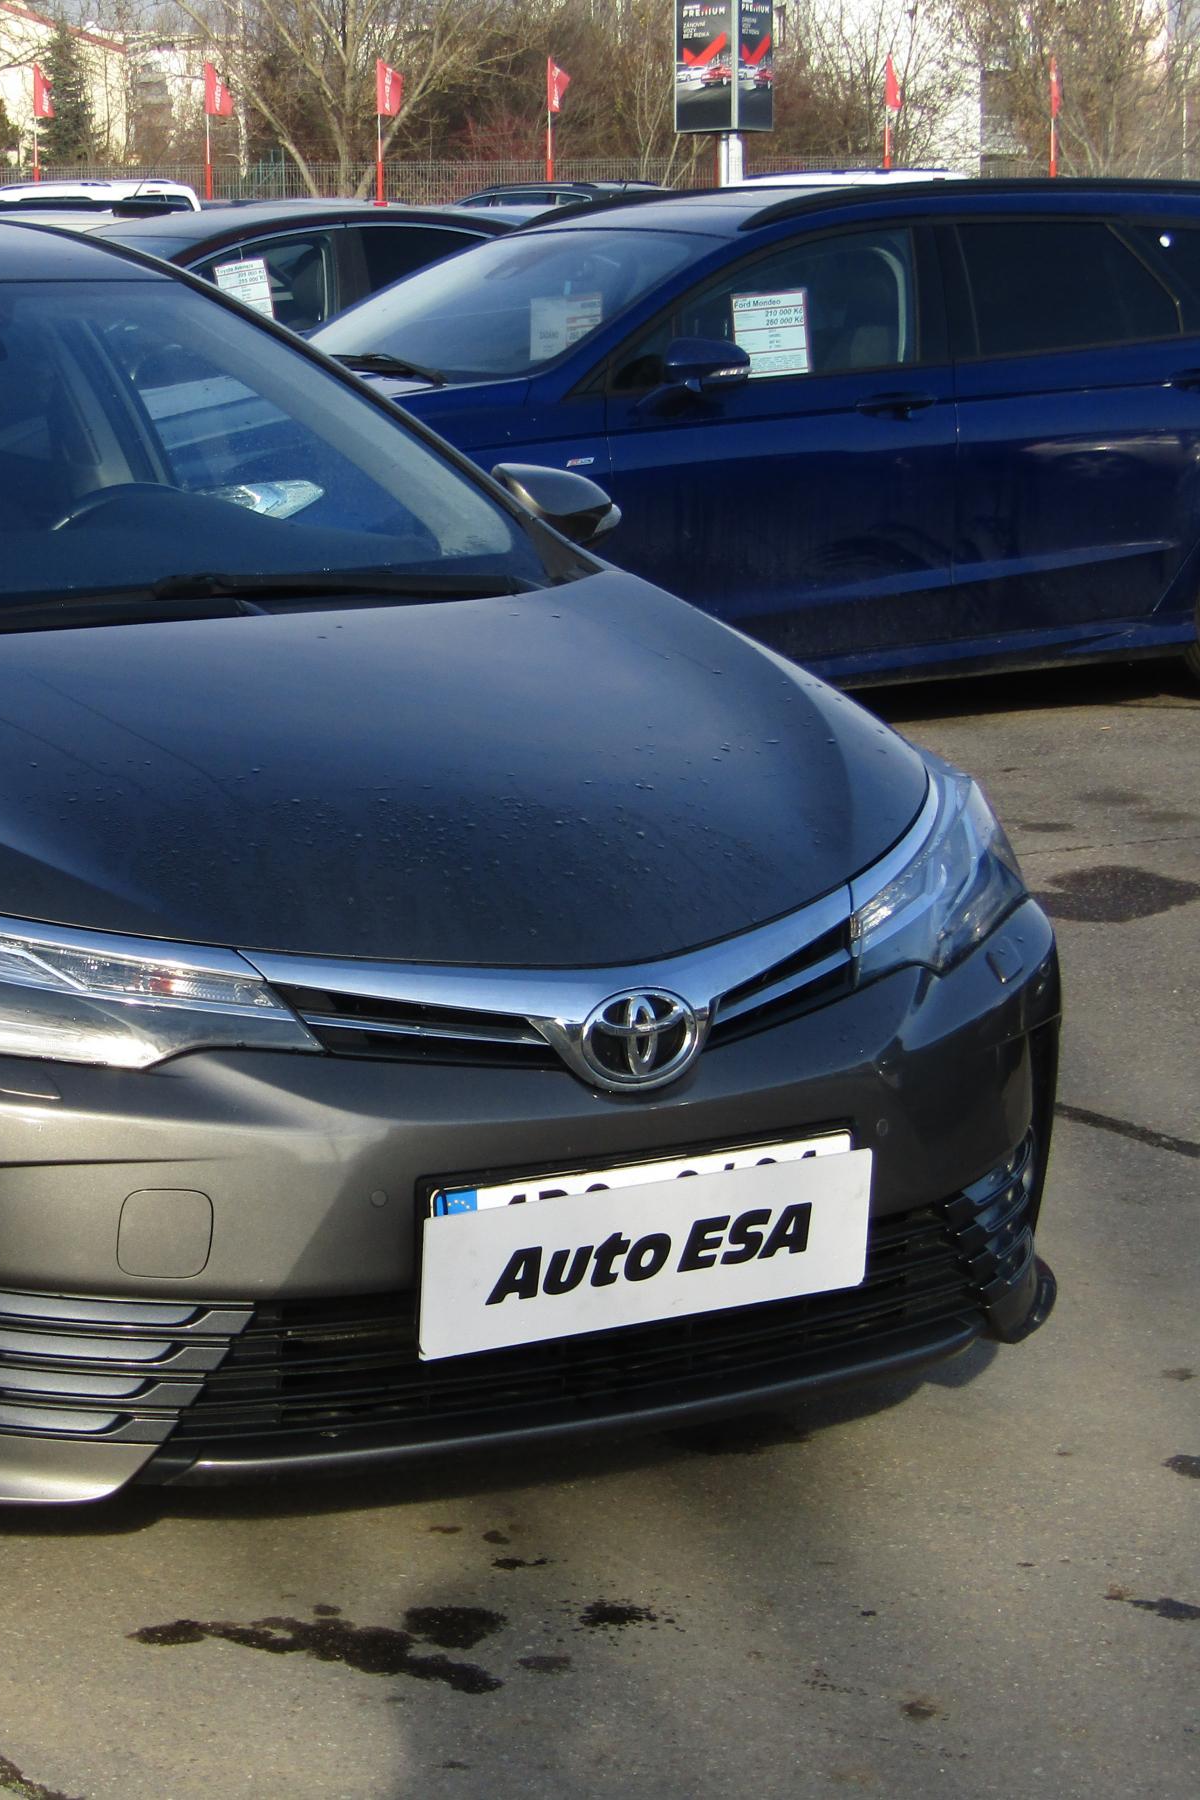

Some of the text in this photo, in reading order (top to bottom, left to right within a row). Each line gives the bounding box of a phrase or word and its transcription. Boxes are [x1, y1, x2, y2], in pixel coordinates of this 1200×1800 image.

[683, 7, 726, 18] PREMIUM
[734, 299, 781, 309] Ford Mondeo
[485, 1202, 813, 1305] Auto ESA
